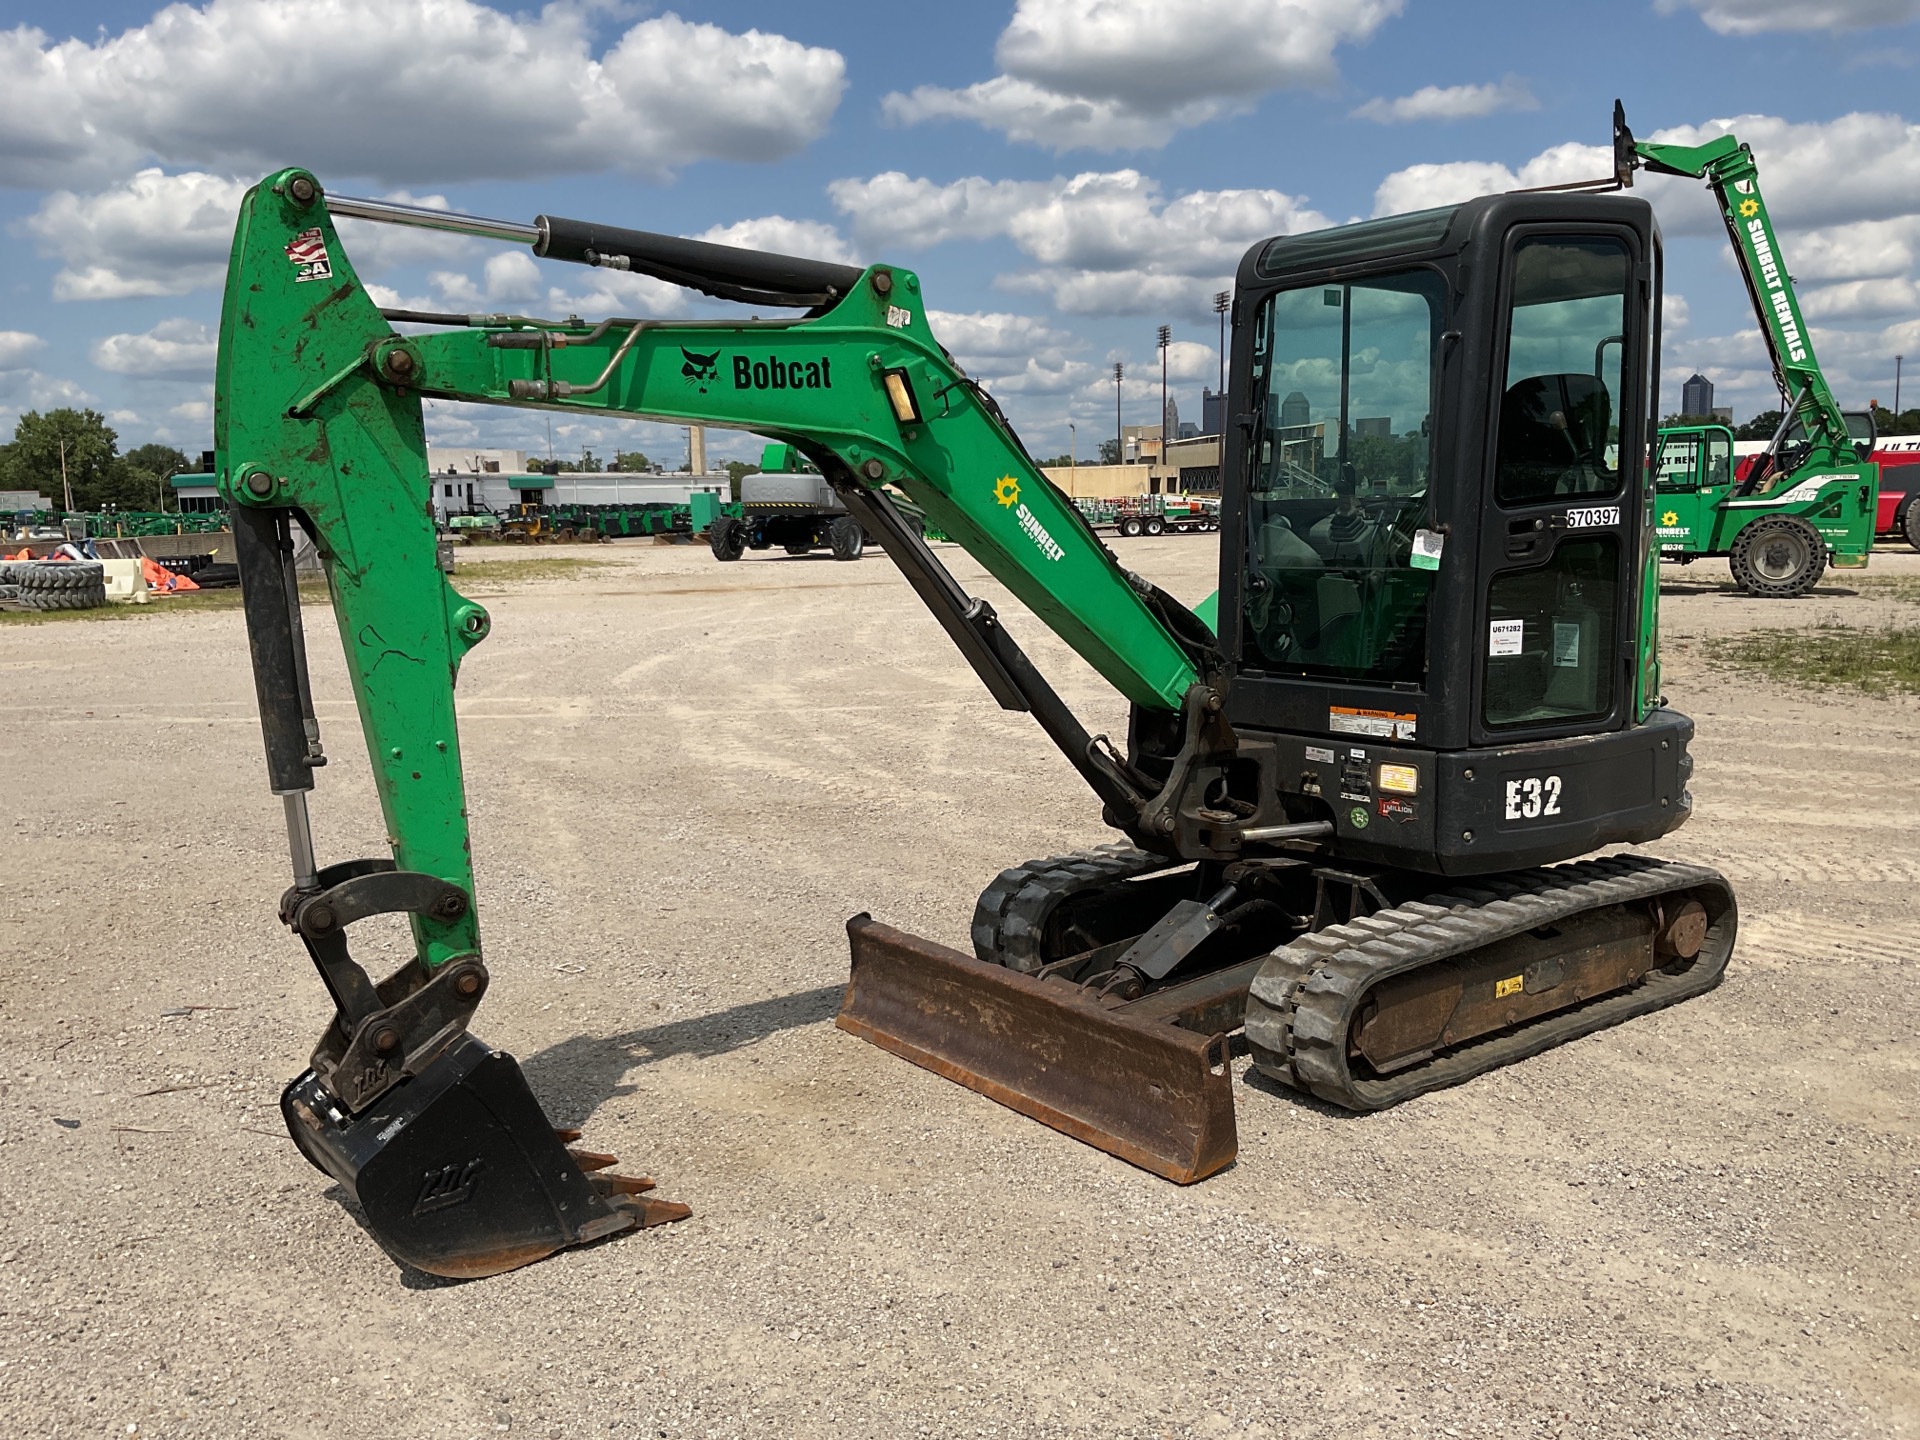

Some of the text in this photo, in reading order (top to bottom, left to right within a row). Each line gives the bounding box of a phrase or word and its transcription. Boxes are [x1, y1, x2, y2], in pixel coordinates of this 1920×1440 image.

[1747, 218, 1807, 363] SUNBELT RENTALS
[733, 355, 831, 390] Bobcat
[1015, 503, 1066, 562] SUNBELT
[1567, 509, 1619, 527] 670397
[1018, 520, 1052, 561] RENTALS
[1492, 625, 1521, 633] U671282
[1387, 804, 1413, 814] MILLION
[1505, 775, 1562, 820] E32
